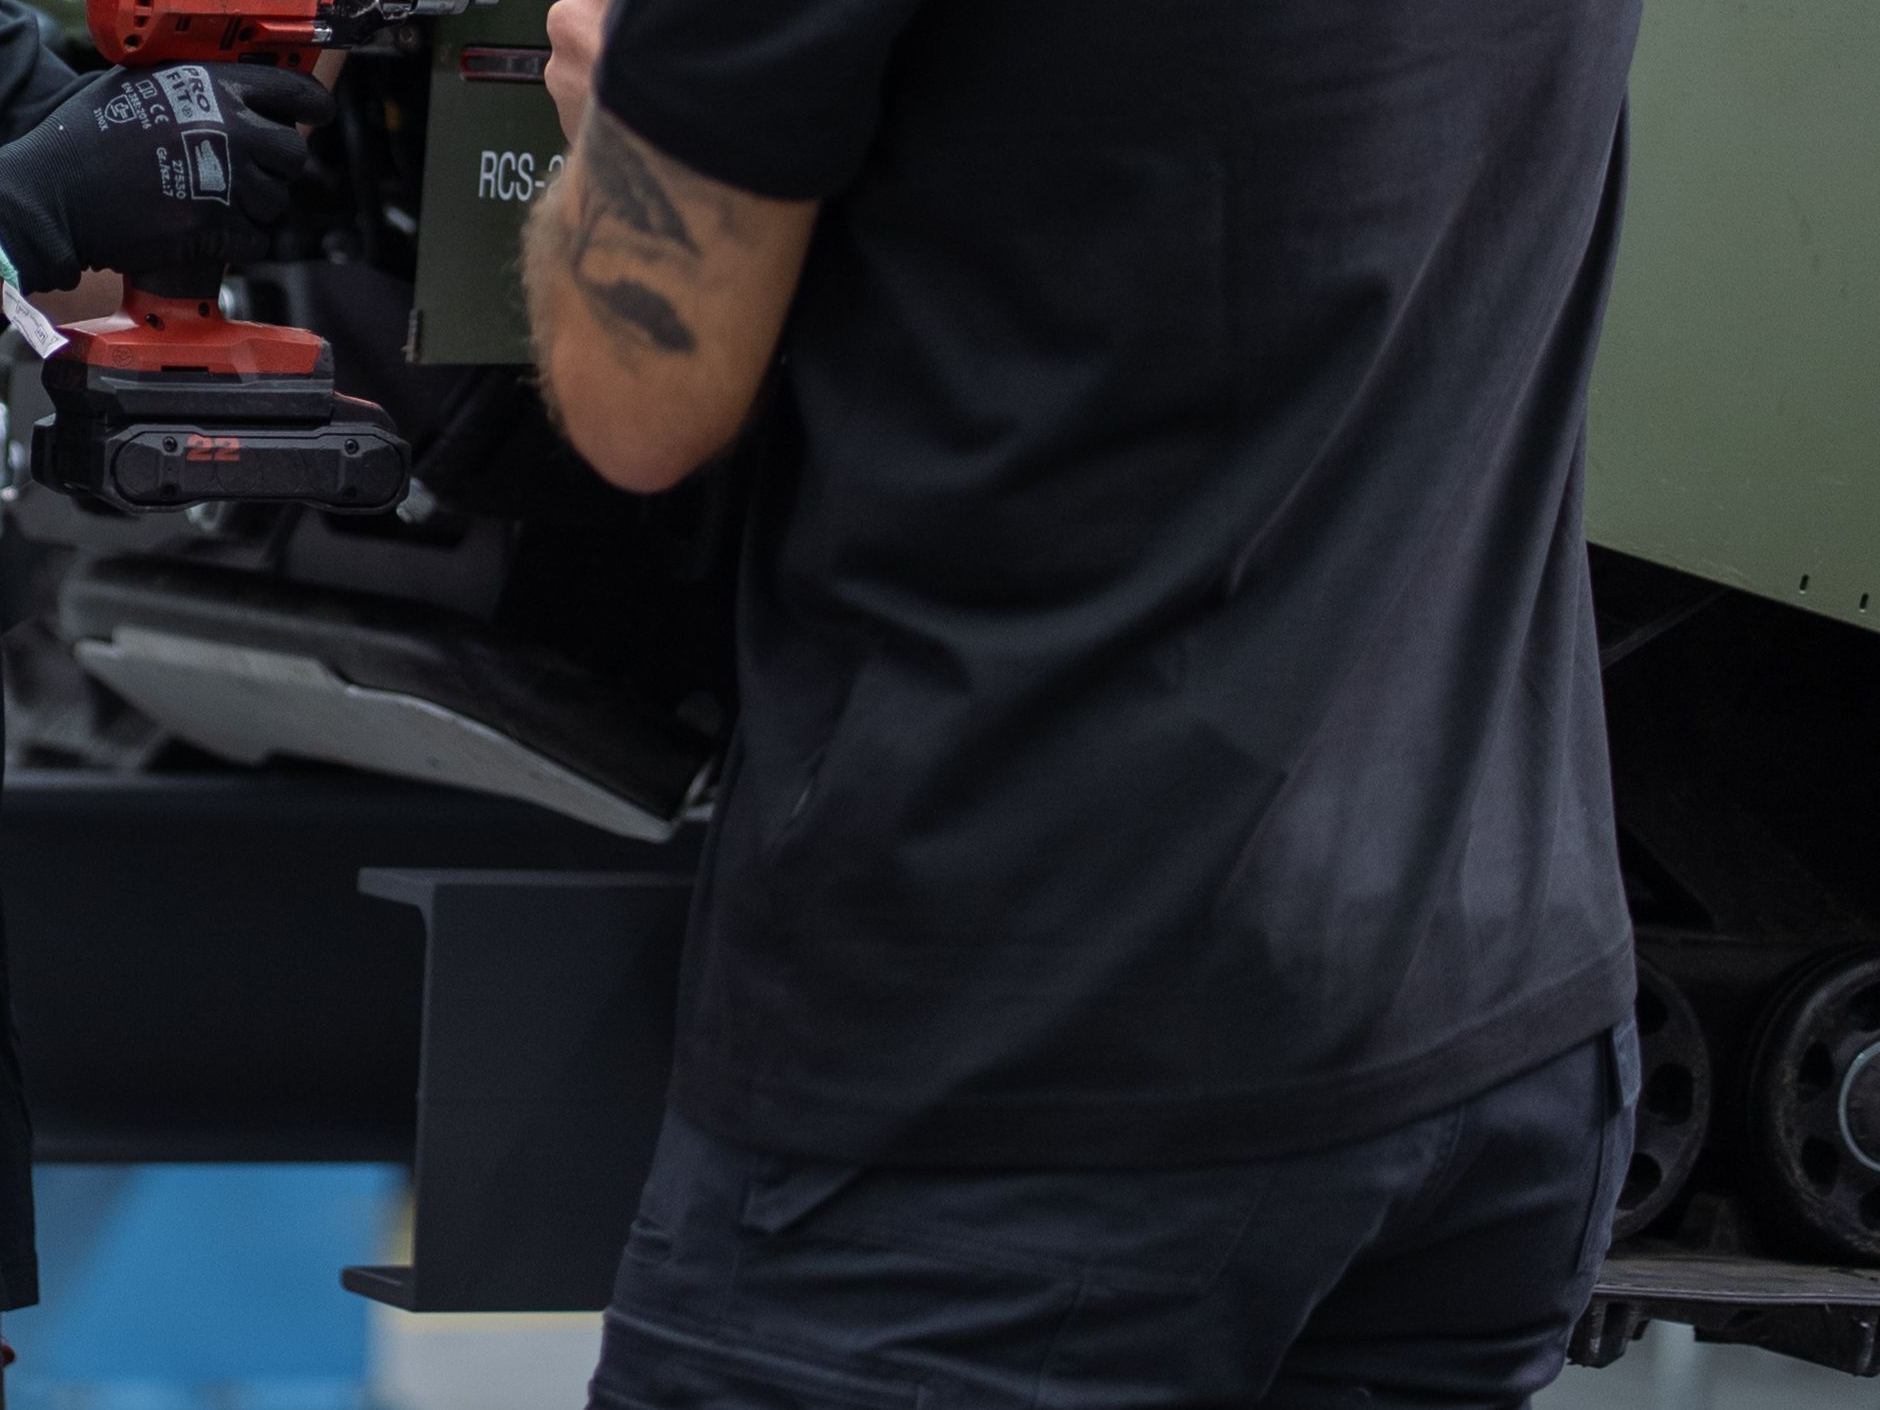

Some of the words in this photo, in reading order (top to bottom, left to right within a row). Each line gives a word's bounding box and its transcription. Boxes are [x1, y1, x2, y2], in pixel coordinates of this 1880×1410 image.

[185, 67, 211, 113] PRO
[171, 159, 187, 199] 27530
[186, 433, 240, 461] 22
